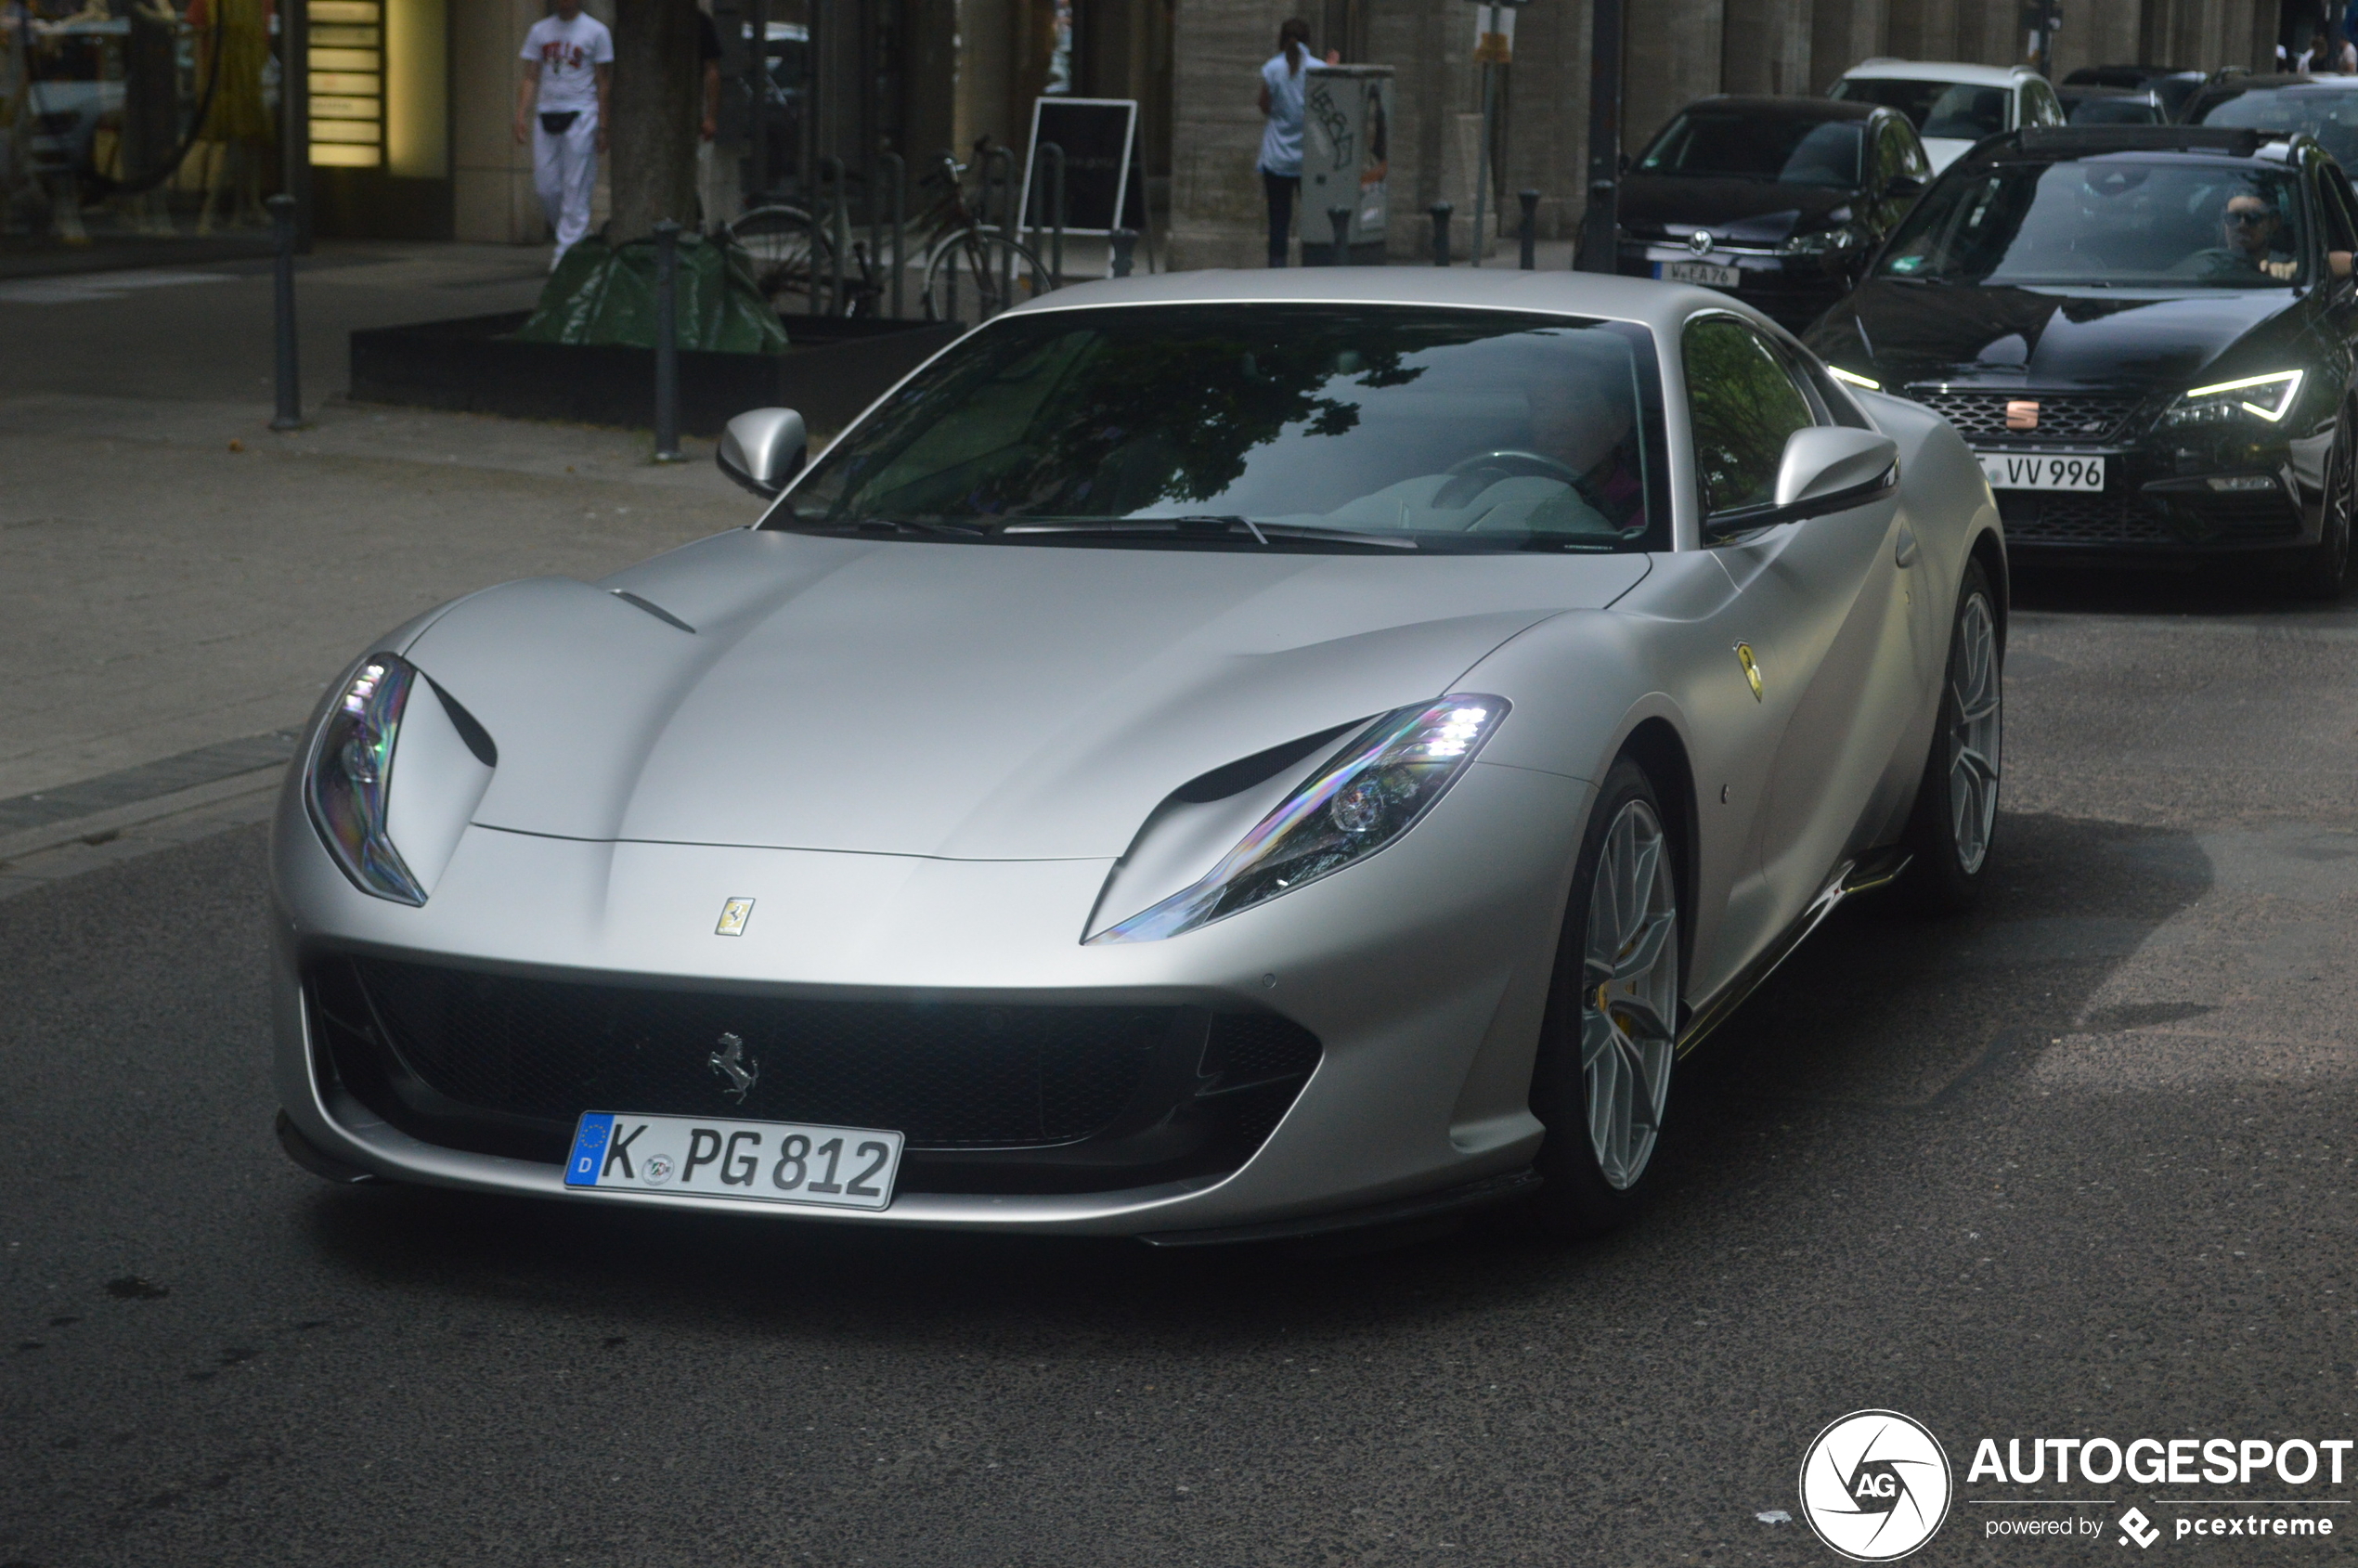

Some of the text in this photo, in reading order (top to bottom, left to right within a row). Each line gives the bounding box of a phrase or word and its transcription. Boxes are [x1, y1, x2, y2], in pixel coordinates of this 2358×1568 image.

[2007, 458, 2101, 486] VV 996
[578, 1157, 593, 1173] D
[602, 1123, 888, 1198] K PG 812
